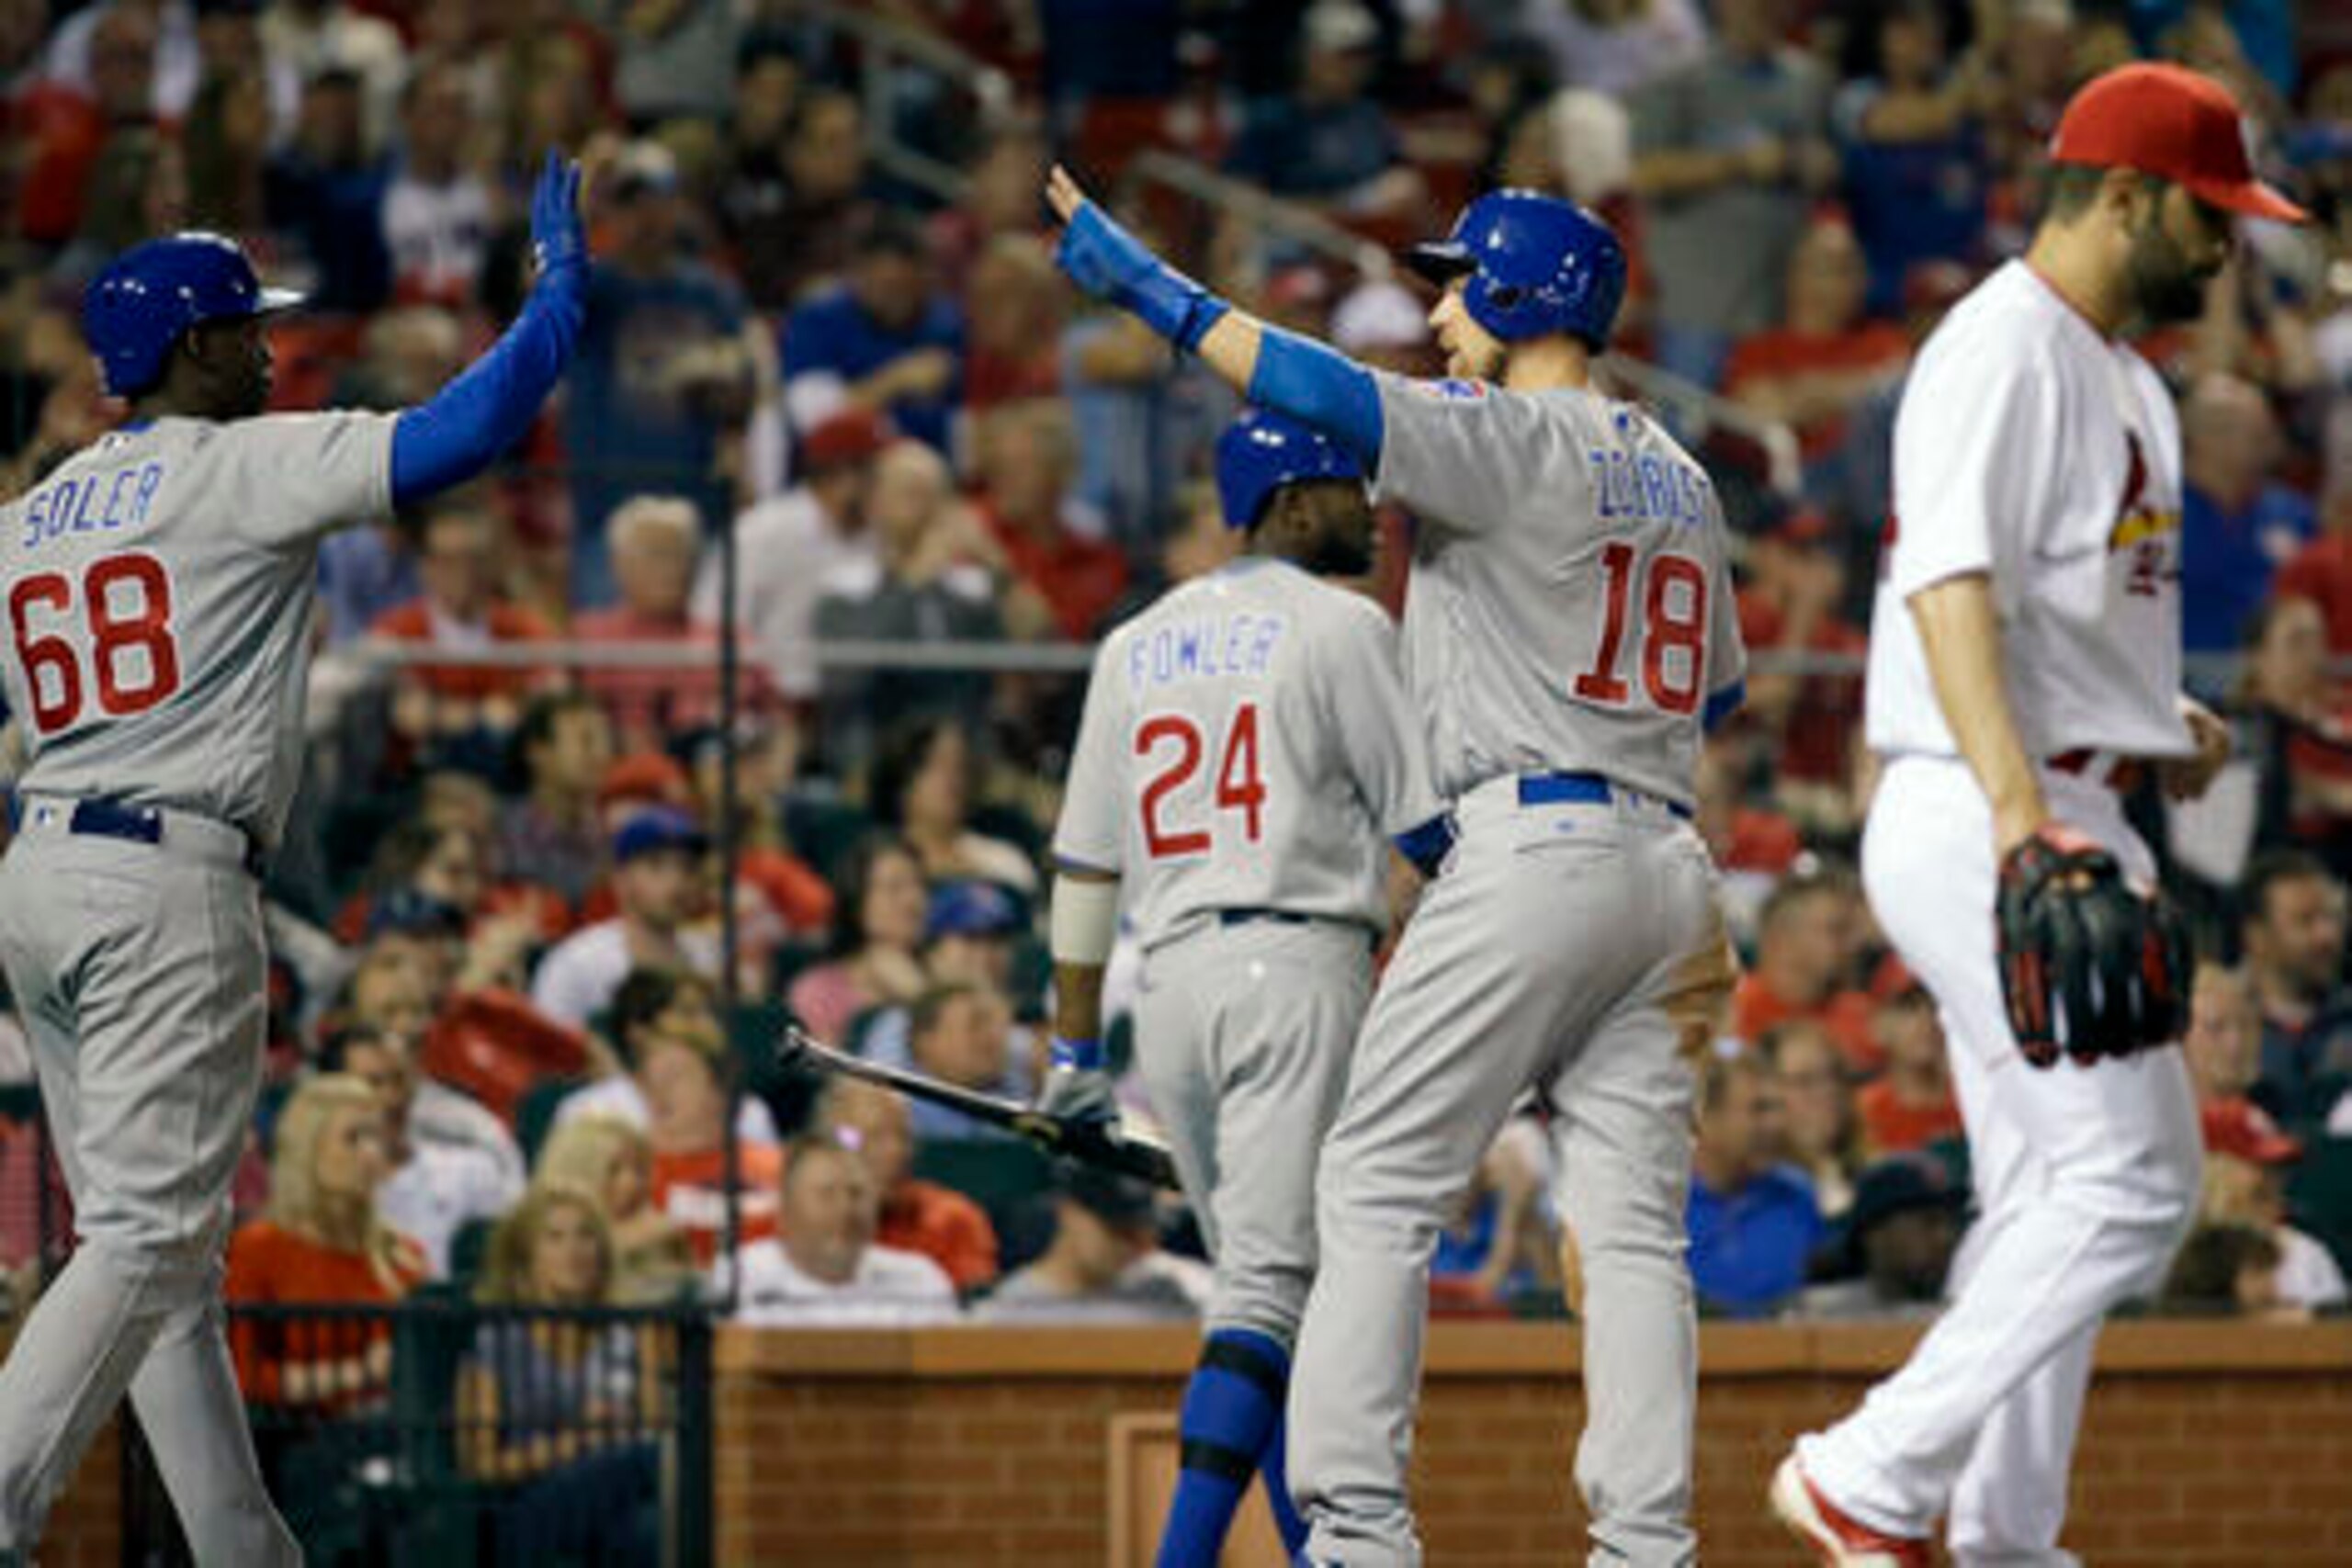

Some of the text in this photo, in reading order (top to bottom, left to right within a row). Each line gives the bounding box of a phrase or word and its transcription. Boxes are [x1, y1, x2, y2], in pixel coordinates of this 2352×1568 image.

[24, 464, 163, 547] SOLER
[8, 553, 179, 734] 68
[1129, 615, 1281, 687] FOWLER
[1574, 541, 1707, 716] 18
[1135, 703, 1267, 859] 24
